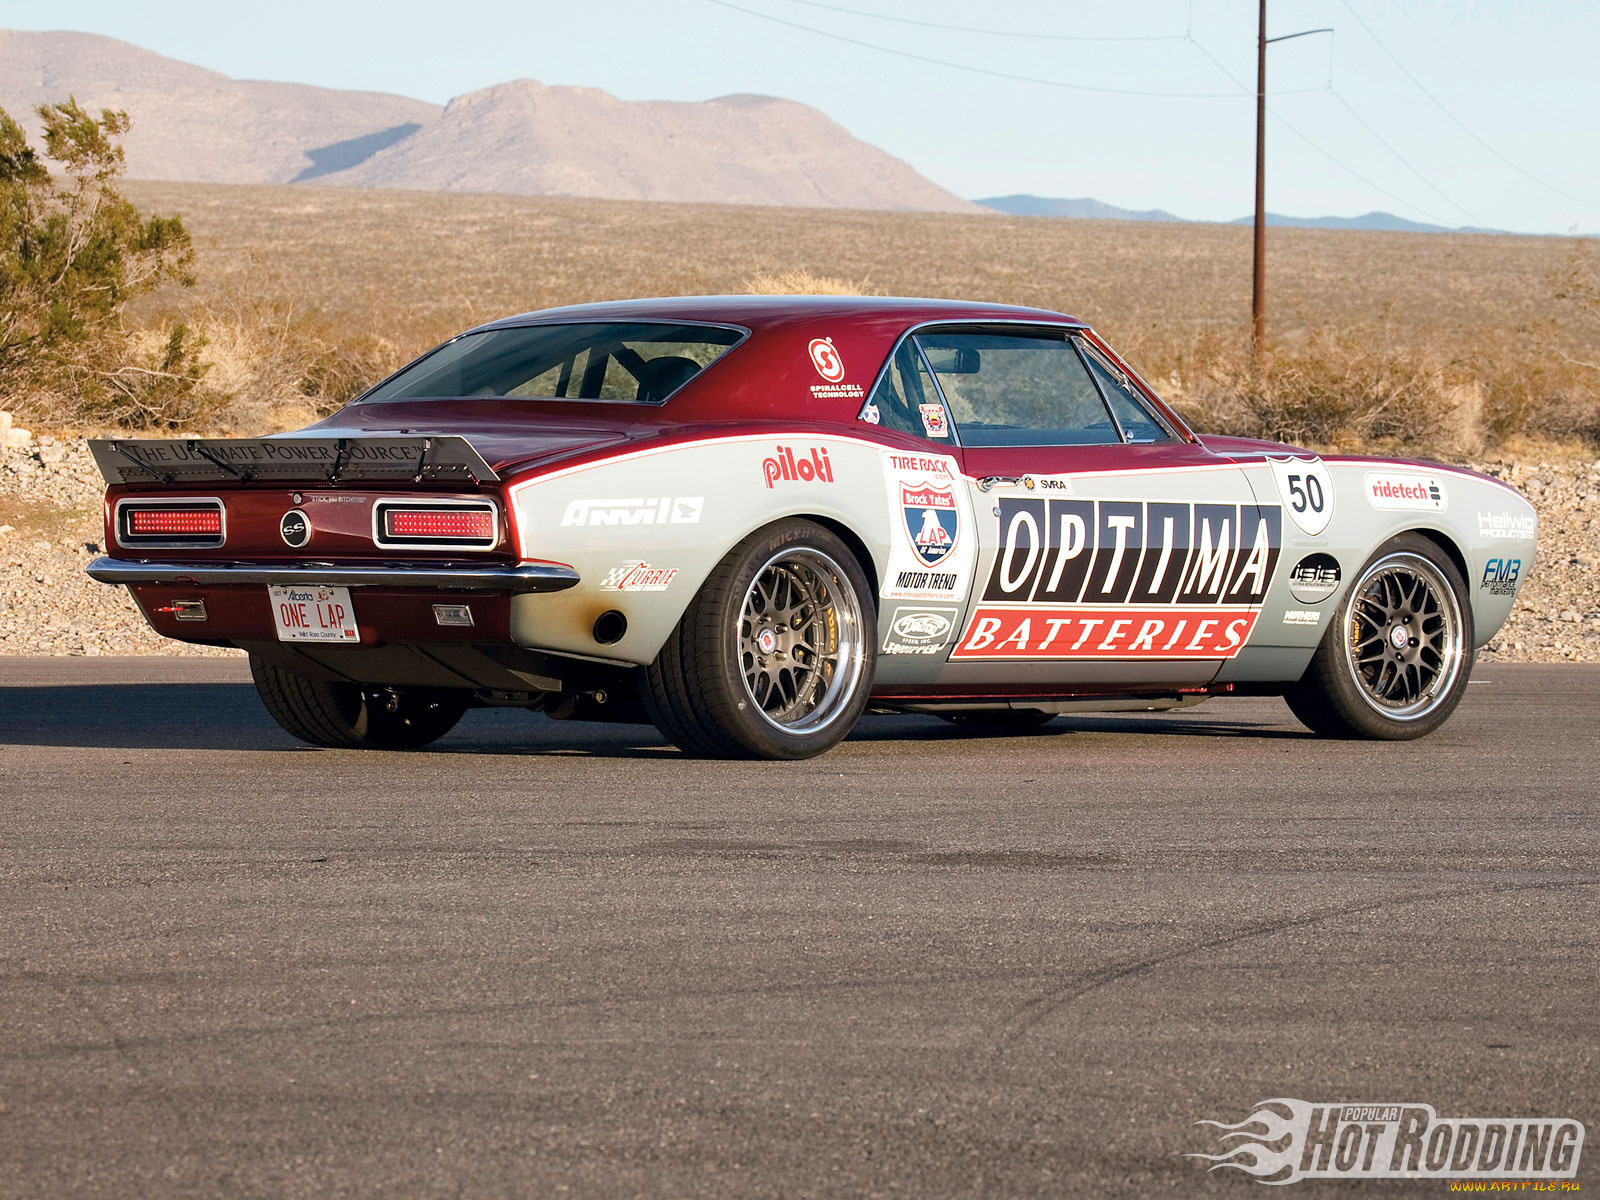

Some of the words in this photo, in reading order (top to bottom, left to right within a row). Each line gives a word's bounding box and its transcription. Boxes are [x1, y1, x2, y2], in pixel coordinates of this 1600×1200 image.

[127, 444, 171, 461] THE
[262, 443, 333, 460] POWER
[762, 445, 834, 489] piloti
[1040, 480, 1067, 489] SVRA
[1288, 474, 1324, 513] 50
[1372, 481, 1428, 500] ridetech
[905, 493, 927, 504] Brock
[283, 522, 304, 536] SS
[1477, 511, 1534, 535] Hellwig
[919, 527, 946, 544] LAP
[999, 510, 1269, 595] OPTIMA
[1482, 558, 1521, 581] FM3
[895, 571, 929, 589] MOTOR
[927, 573, 957, 590] TREND
[1480, 578, 1515, 589] performance
[1489, 586, 1516, 597] marketing
[280, 603, 310, 628] ONE
[317, 604, 345, 629] LAP
[964, 616, 1248, 651] BATTERIES
